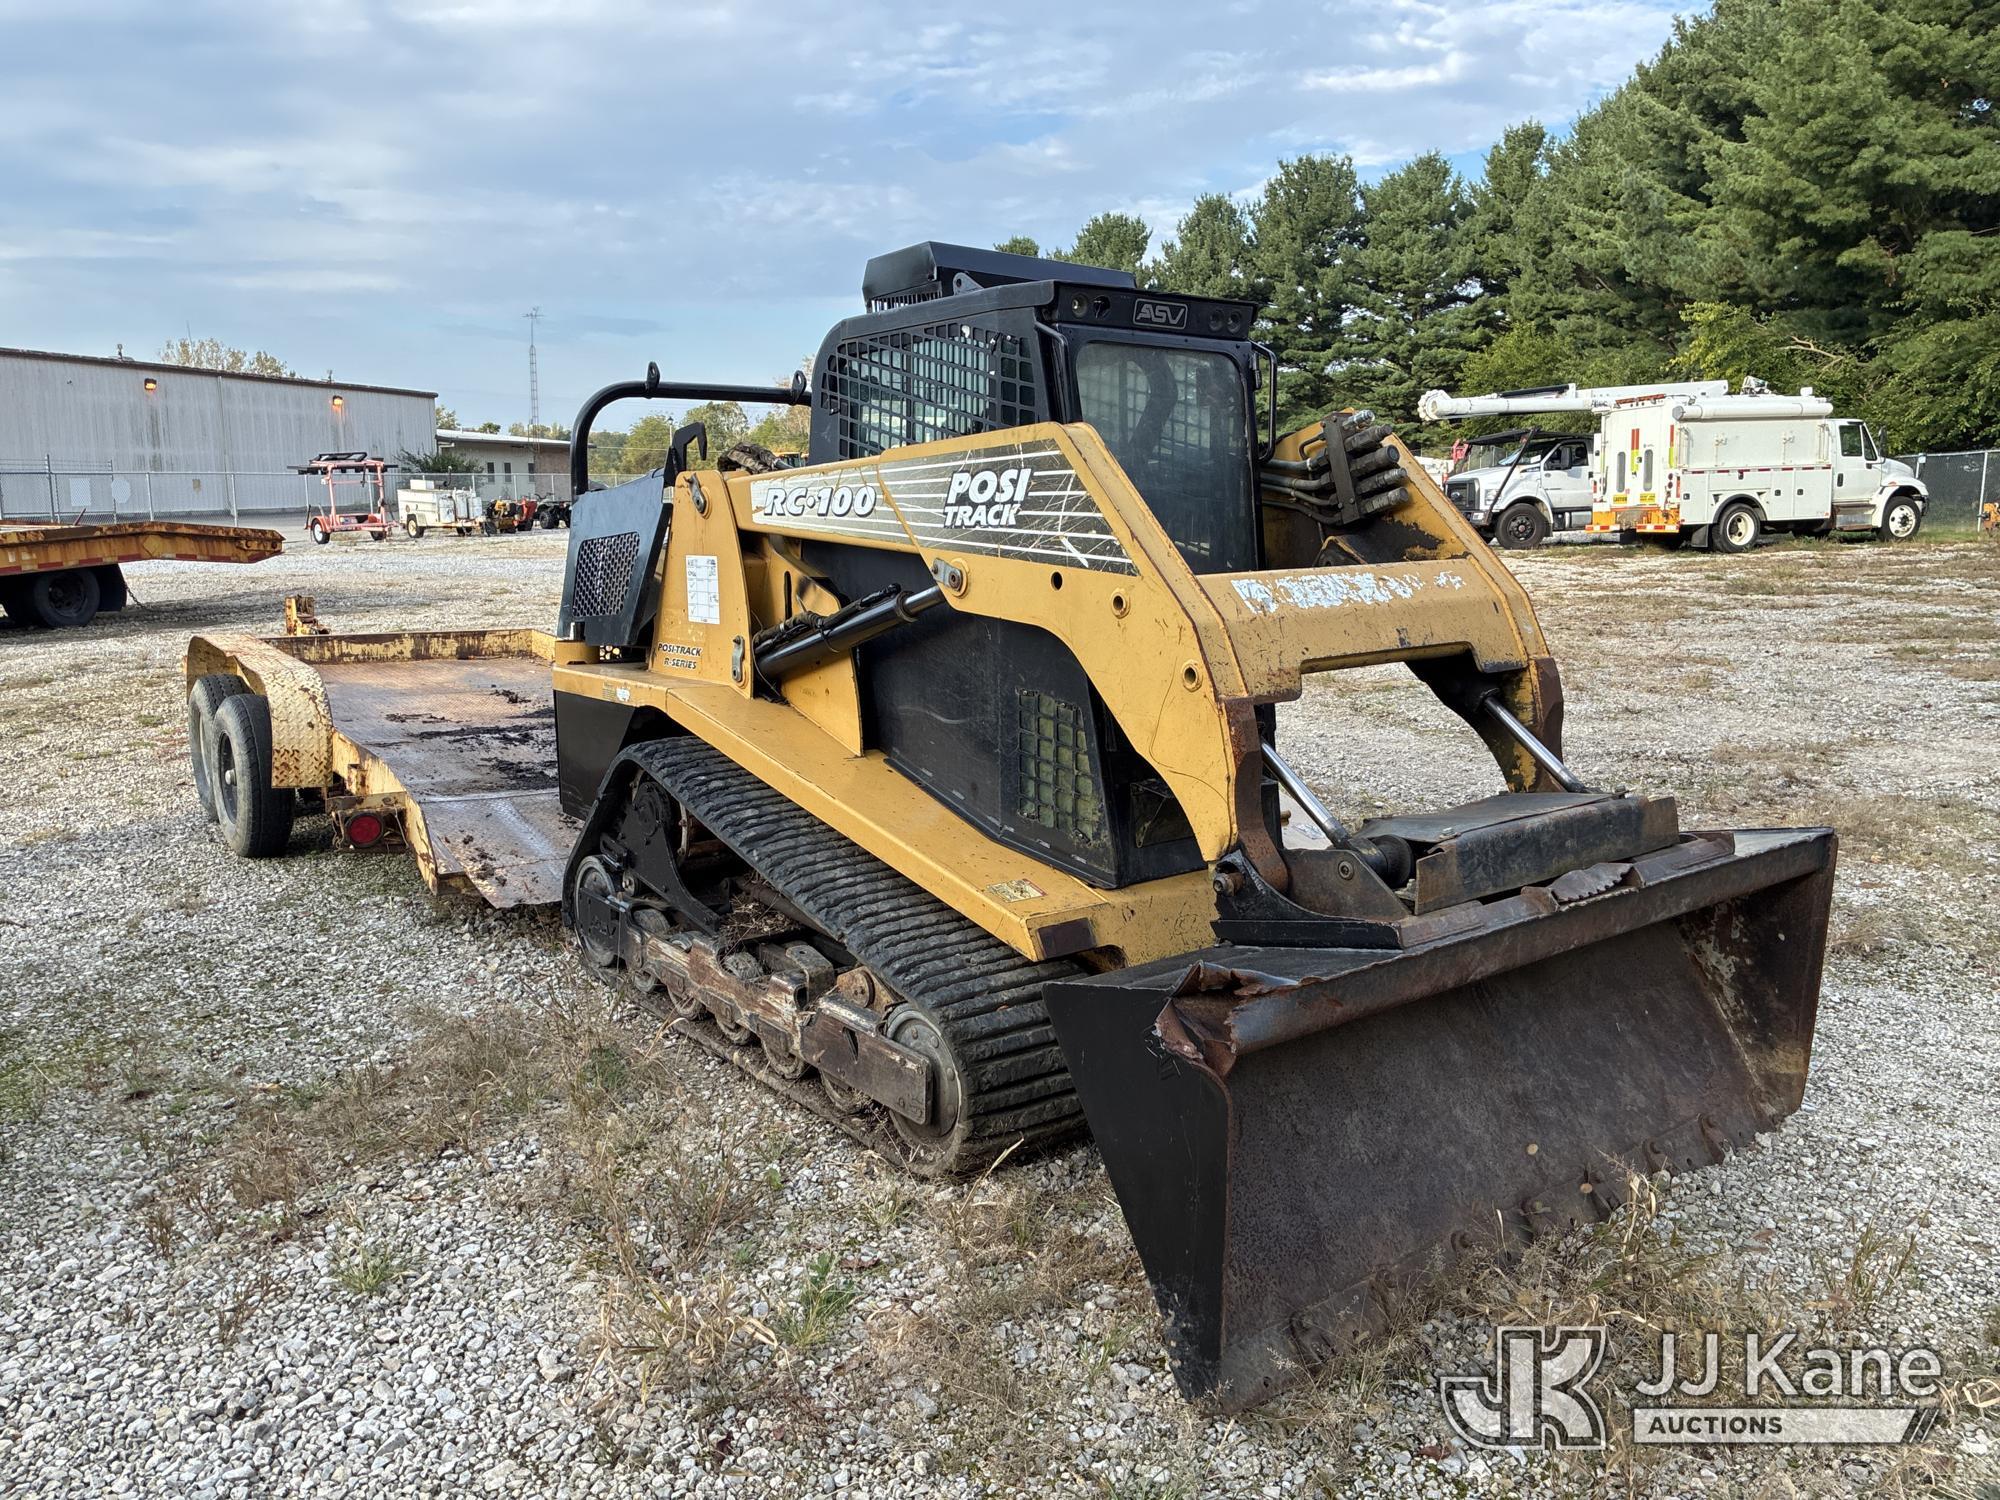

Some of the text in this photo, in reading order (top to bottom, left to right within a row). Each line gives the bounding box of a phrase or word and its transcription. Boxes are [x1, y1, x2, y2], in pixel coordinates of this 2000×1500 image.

[1136, 303, 1185, 325] ASV
[946, 468, 1032, 504] POSI
[944, 503, 1021, 528] TRACK
[664, 657, 697, 669] R-SERIES
